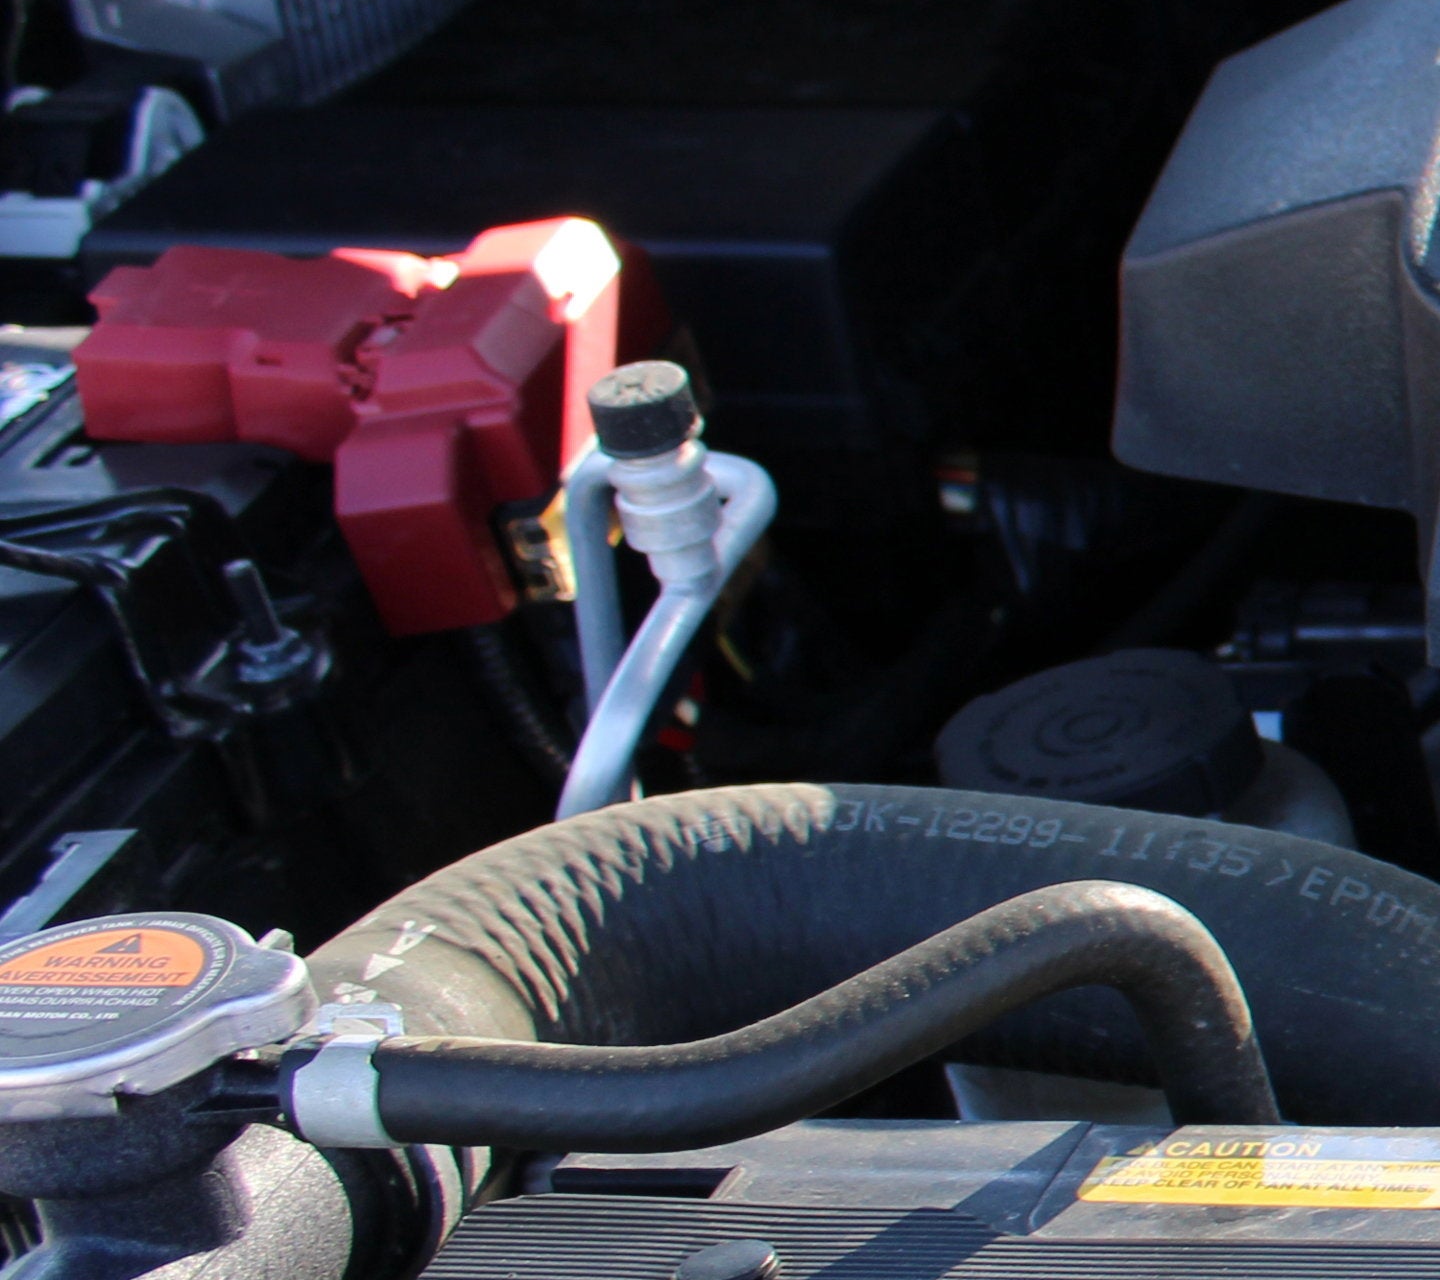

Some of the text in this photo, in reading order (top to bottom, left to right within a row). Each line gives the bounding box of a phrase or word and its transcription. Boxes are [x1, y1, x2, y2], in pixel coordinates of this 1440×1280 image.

[43, 956, 171, 969] WARNING
[0, 971, 188, 983] AVERTISSEMENT
[35, 986, 80, 995] OPEN
[81, 987, 131, 996] WHEN
[21, 1011, 69, 1019] MOTOR
[1165, 1141, 1322, 1157] CAUTION
[1151, 1161, 1213, 1170] BLADE
[1216, 1161, 1257, 1170] CAN
[1264, 1162, 1324, 1171] START
[1196, 1171, 1301, 1180] PERSONAL
[1152, 1179, 1217, 1188] CLEAR
[1222, 1180, 1251, 1189] OF
[1254, 1181, 1293, 1190] FAN
[1326, 1183, 1365, 1192] ALL
